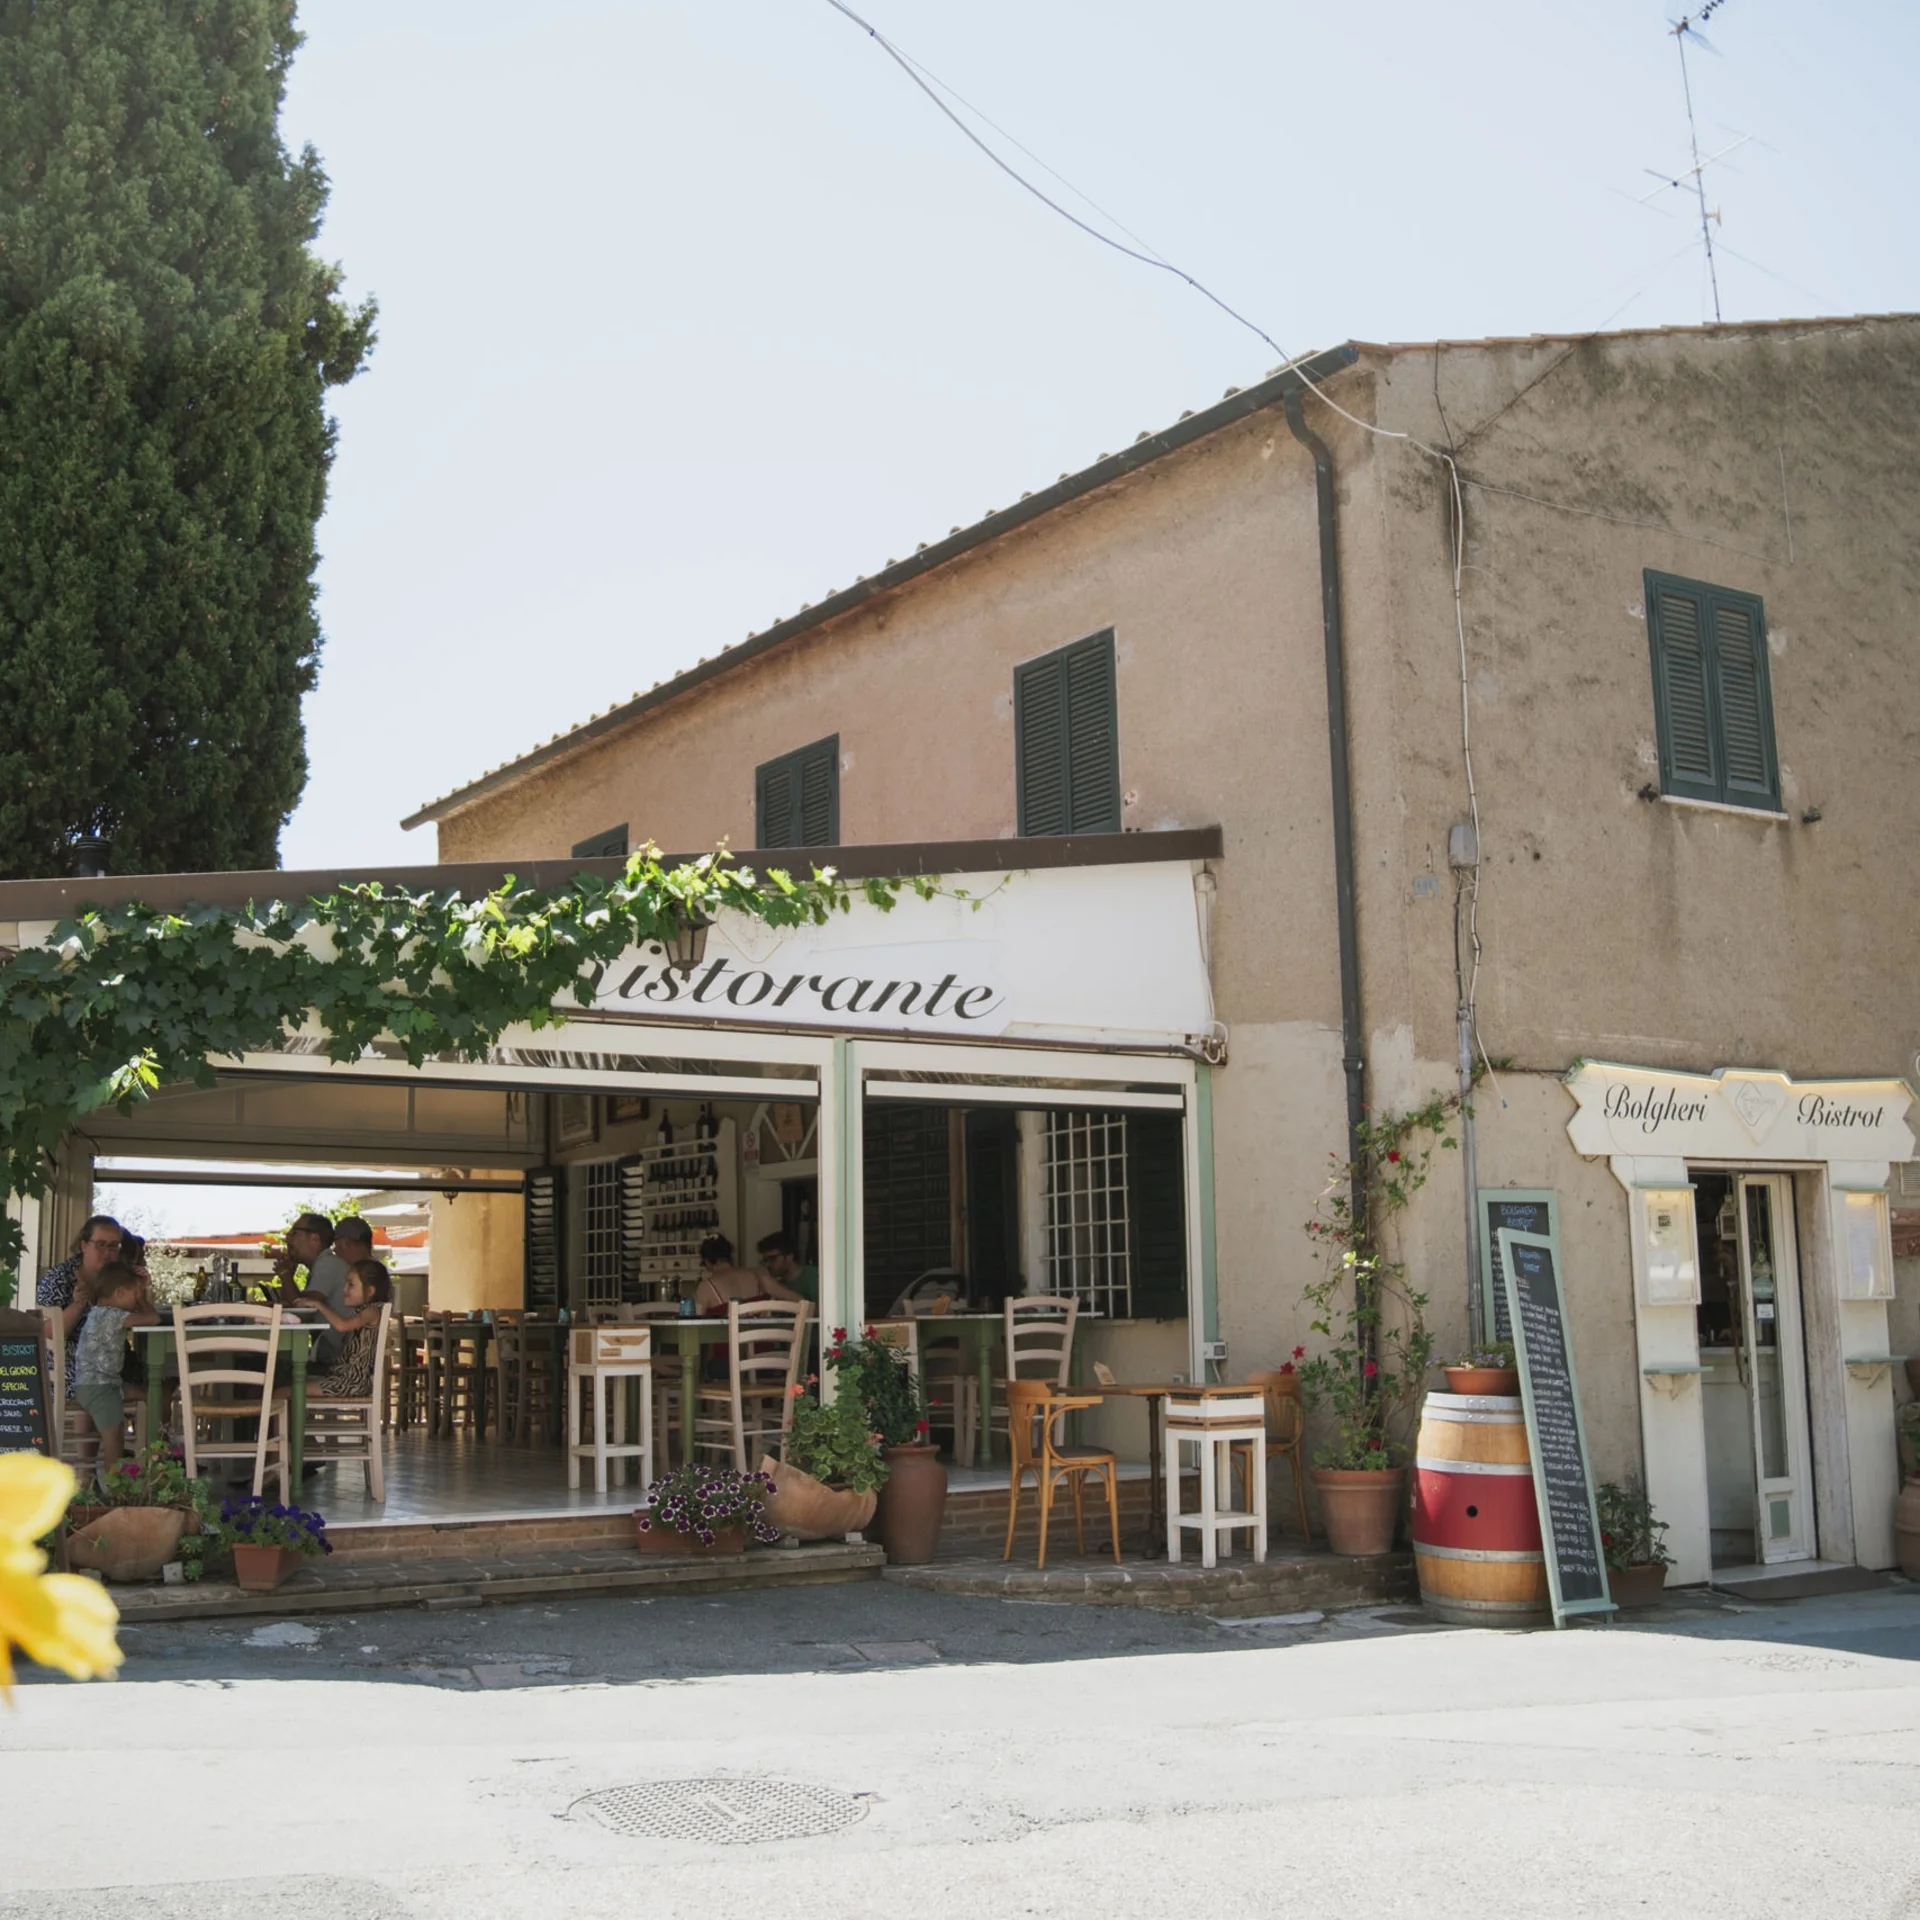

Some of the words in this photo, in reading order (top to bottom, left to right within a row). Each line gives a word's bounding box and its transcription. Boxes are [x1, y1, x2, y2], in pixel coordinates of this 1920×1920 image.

[1603, 1082, 1708, 1134] Bolgheri
[1797, 1092, 1884, 1128] Bistrot
[2, 1344, 36, 1356] BISTROT
[9, 1366, 38, 1376] GIORNO
[2, 1382, 29, 1391] SPECIAL
